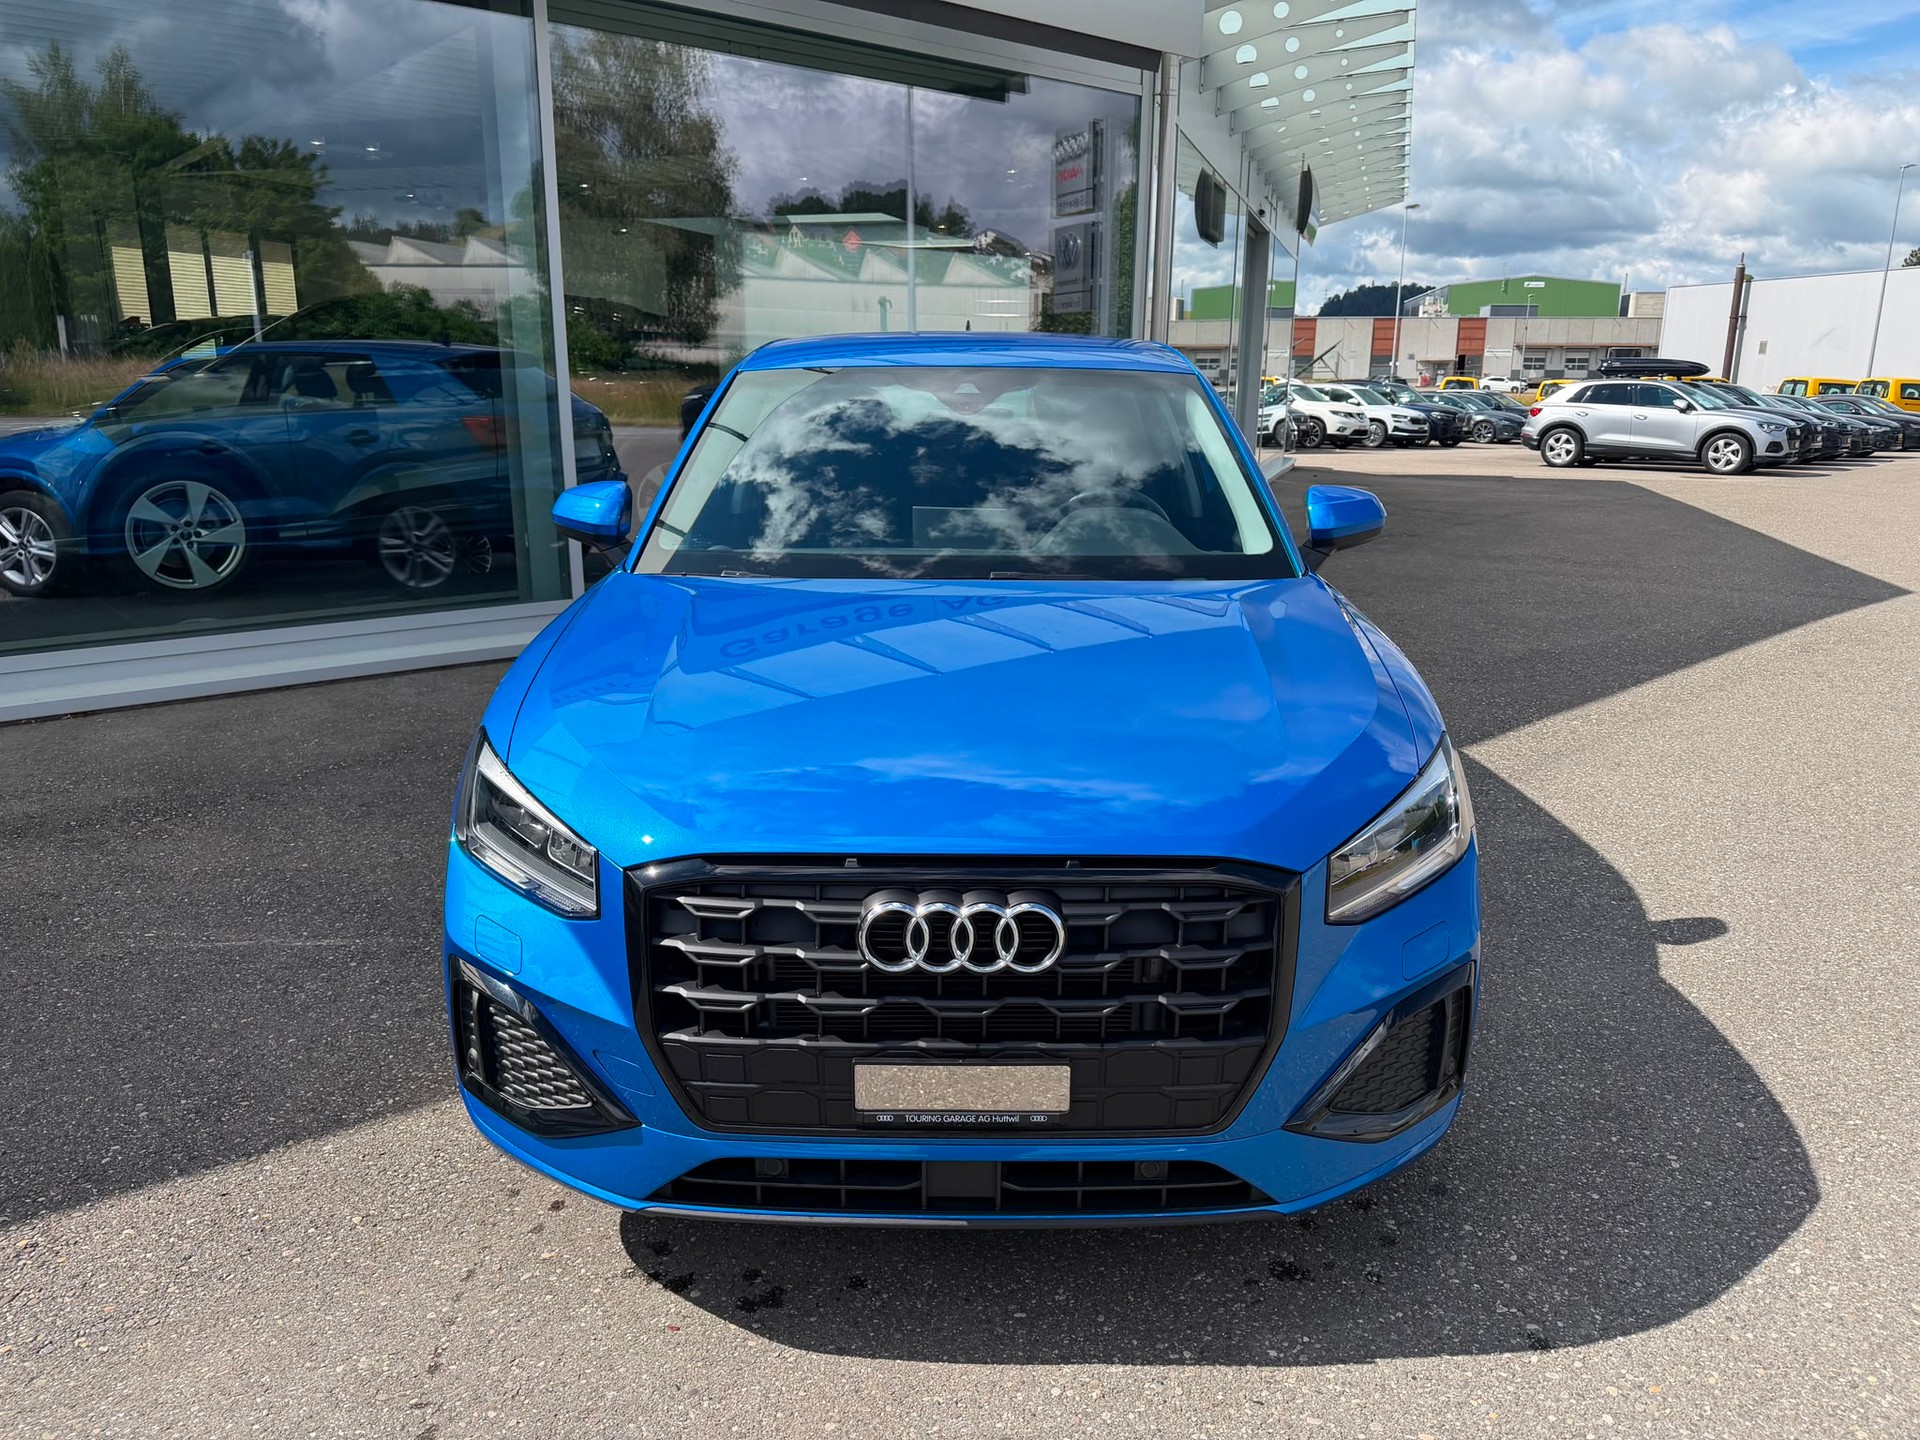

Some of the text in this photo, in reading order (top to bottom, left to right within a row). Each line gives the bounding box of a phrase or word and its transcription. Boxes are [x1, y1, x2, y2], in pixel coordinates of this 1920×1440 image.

[905, 1115, 1020, 1123] TOURING GARAGE AG Huttwil
